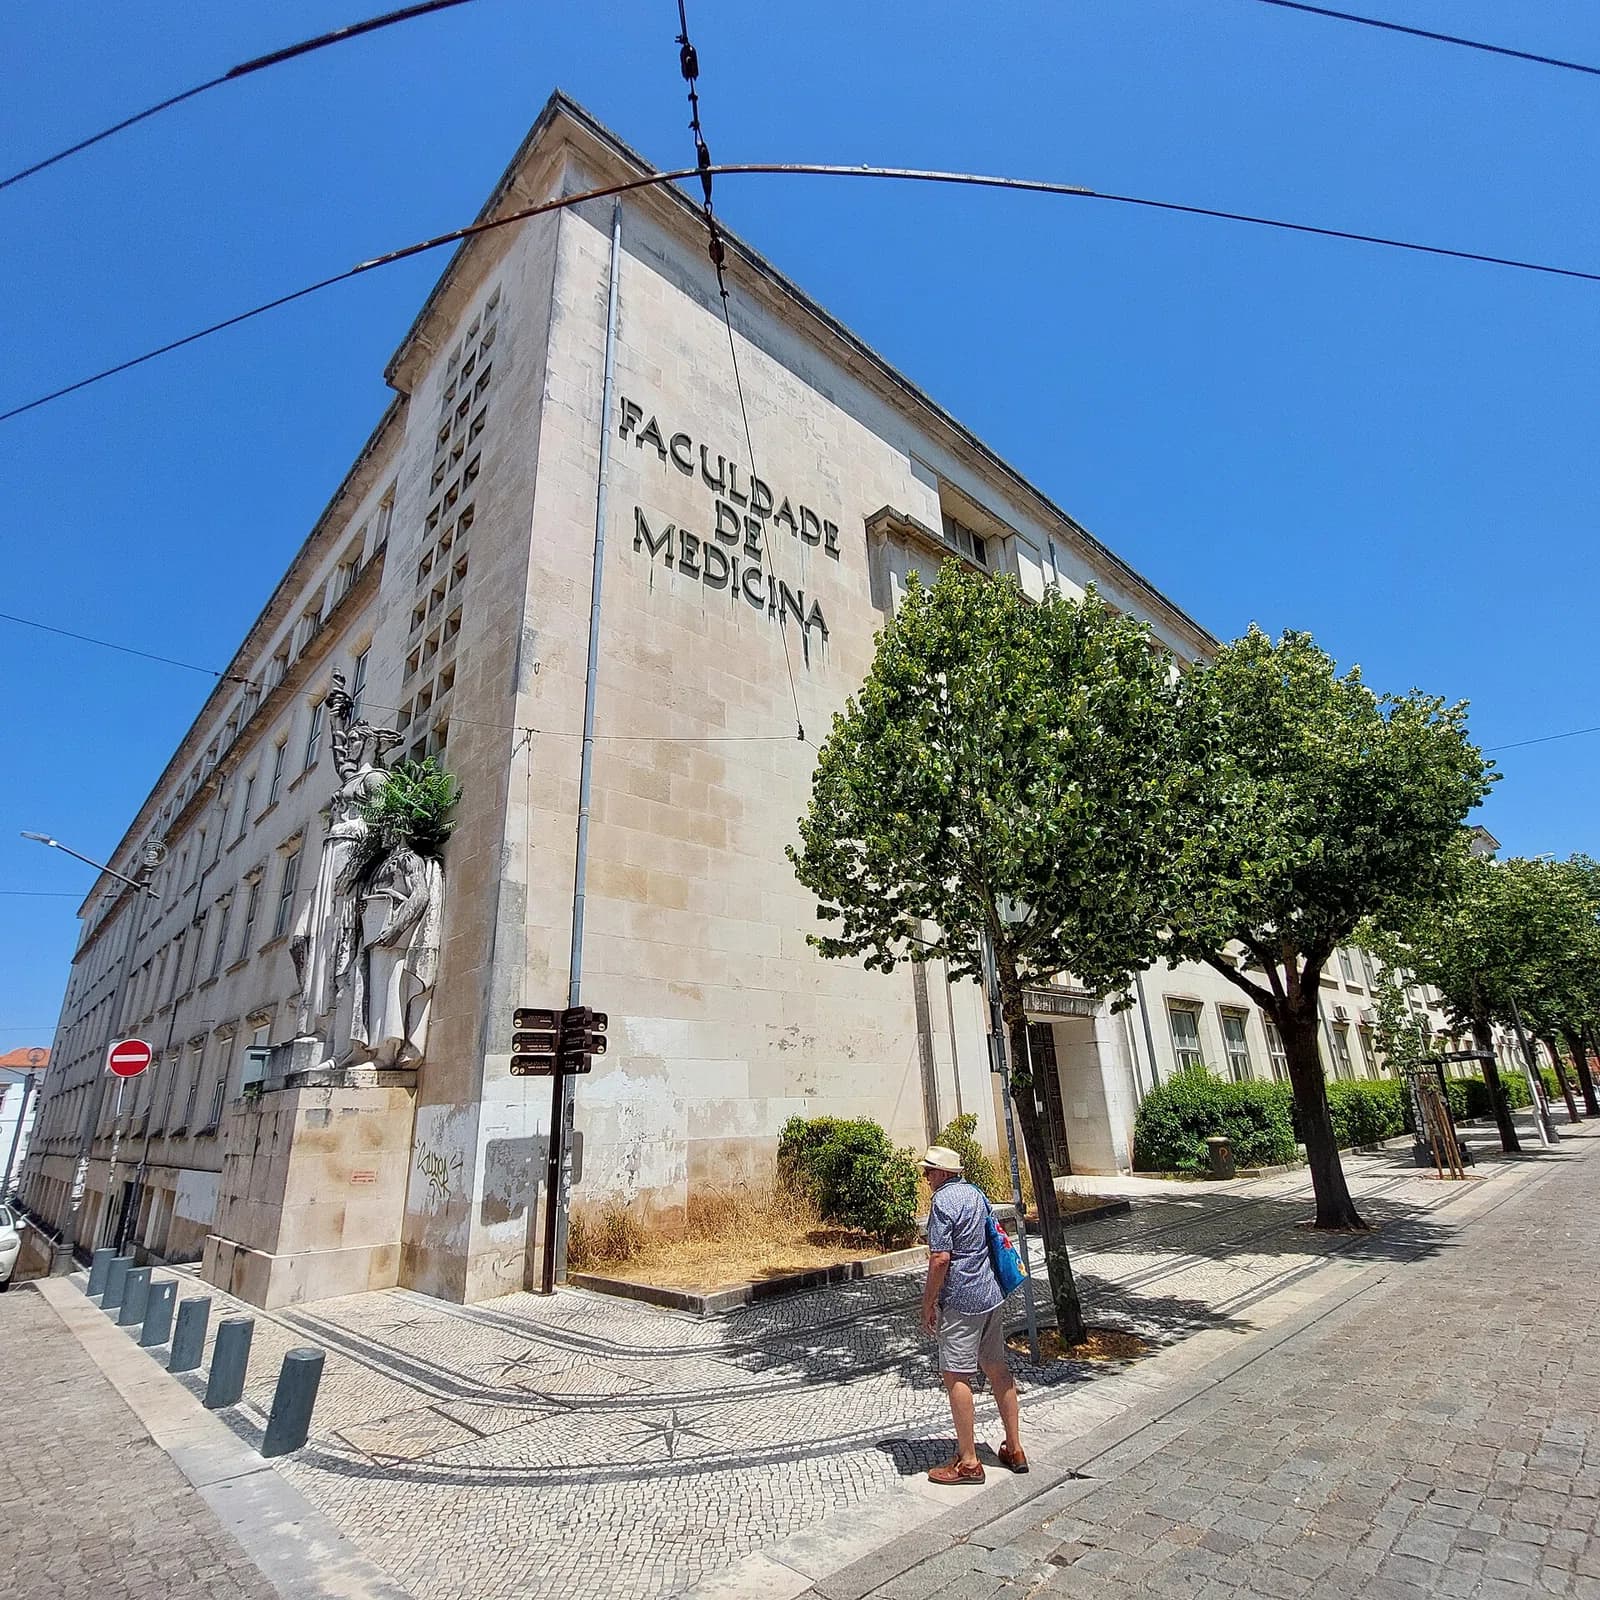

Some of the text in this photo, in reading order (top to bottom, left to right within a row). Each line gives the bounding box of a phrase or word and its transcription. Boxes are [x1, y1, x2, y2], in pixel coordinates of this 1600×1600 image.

[619, 396, 840, 562] FACULDADE
[714, 499, 763, 562] DE
[633, 505, 829, 642] MEDICINA
